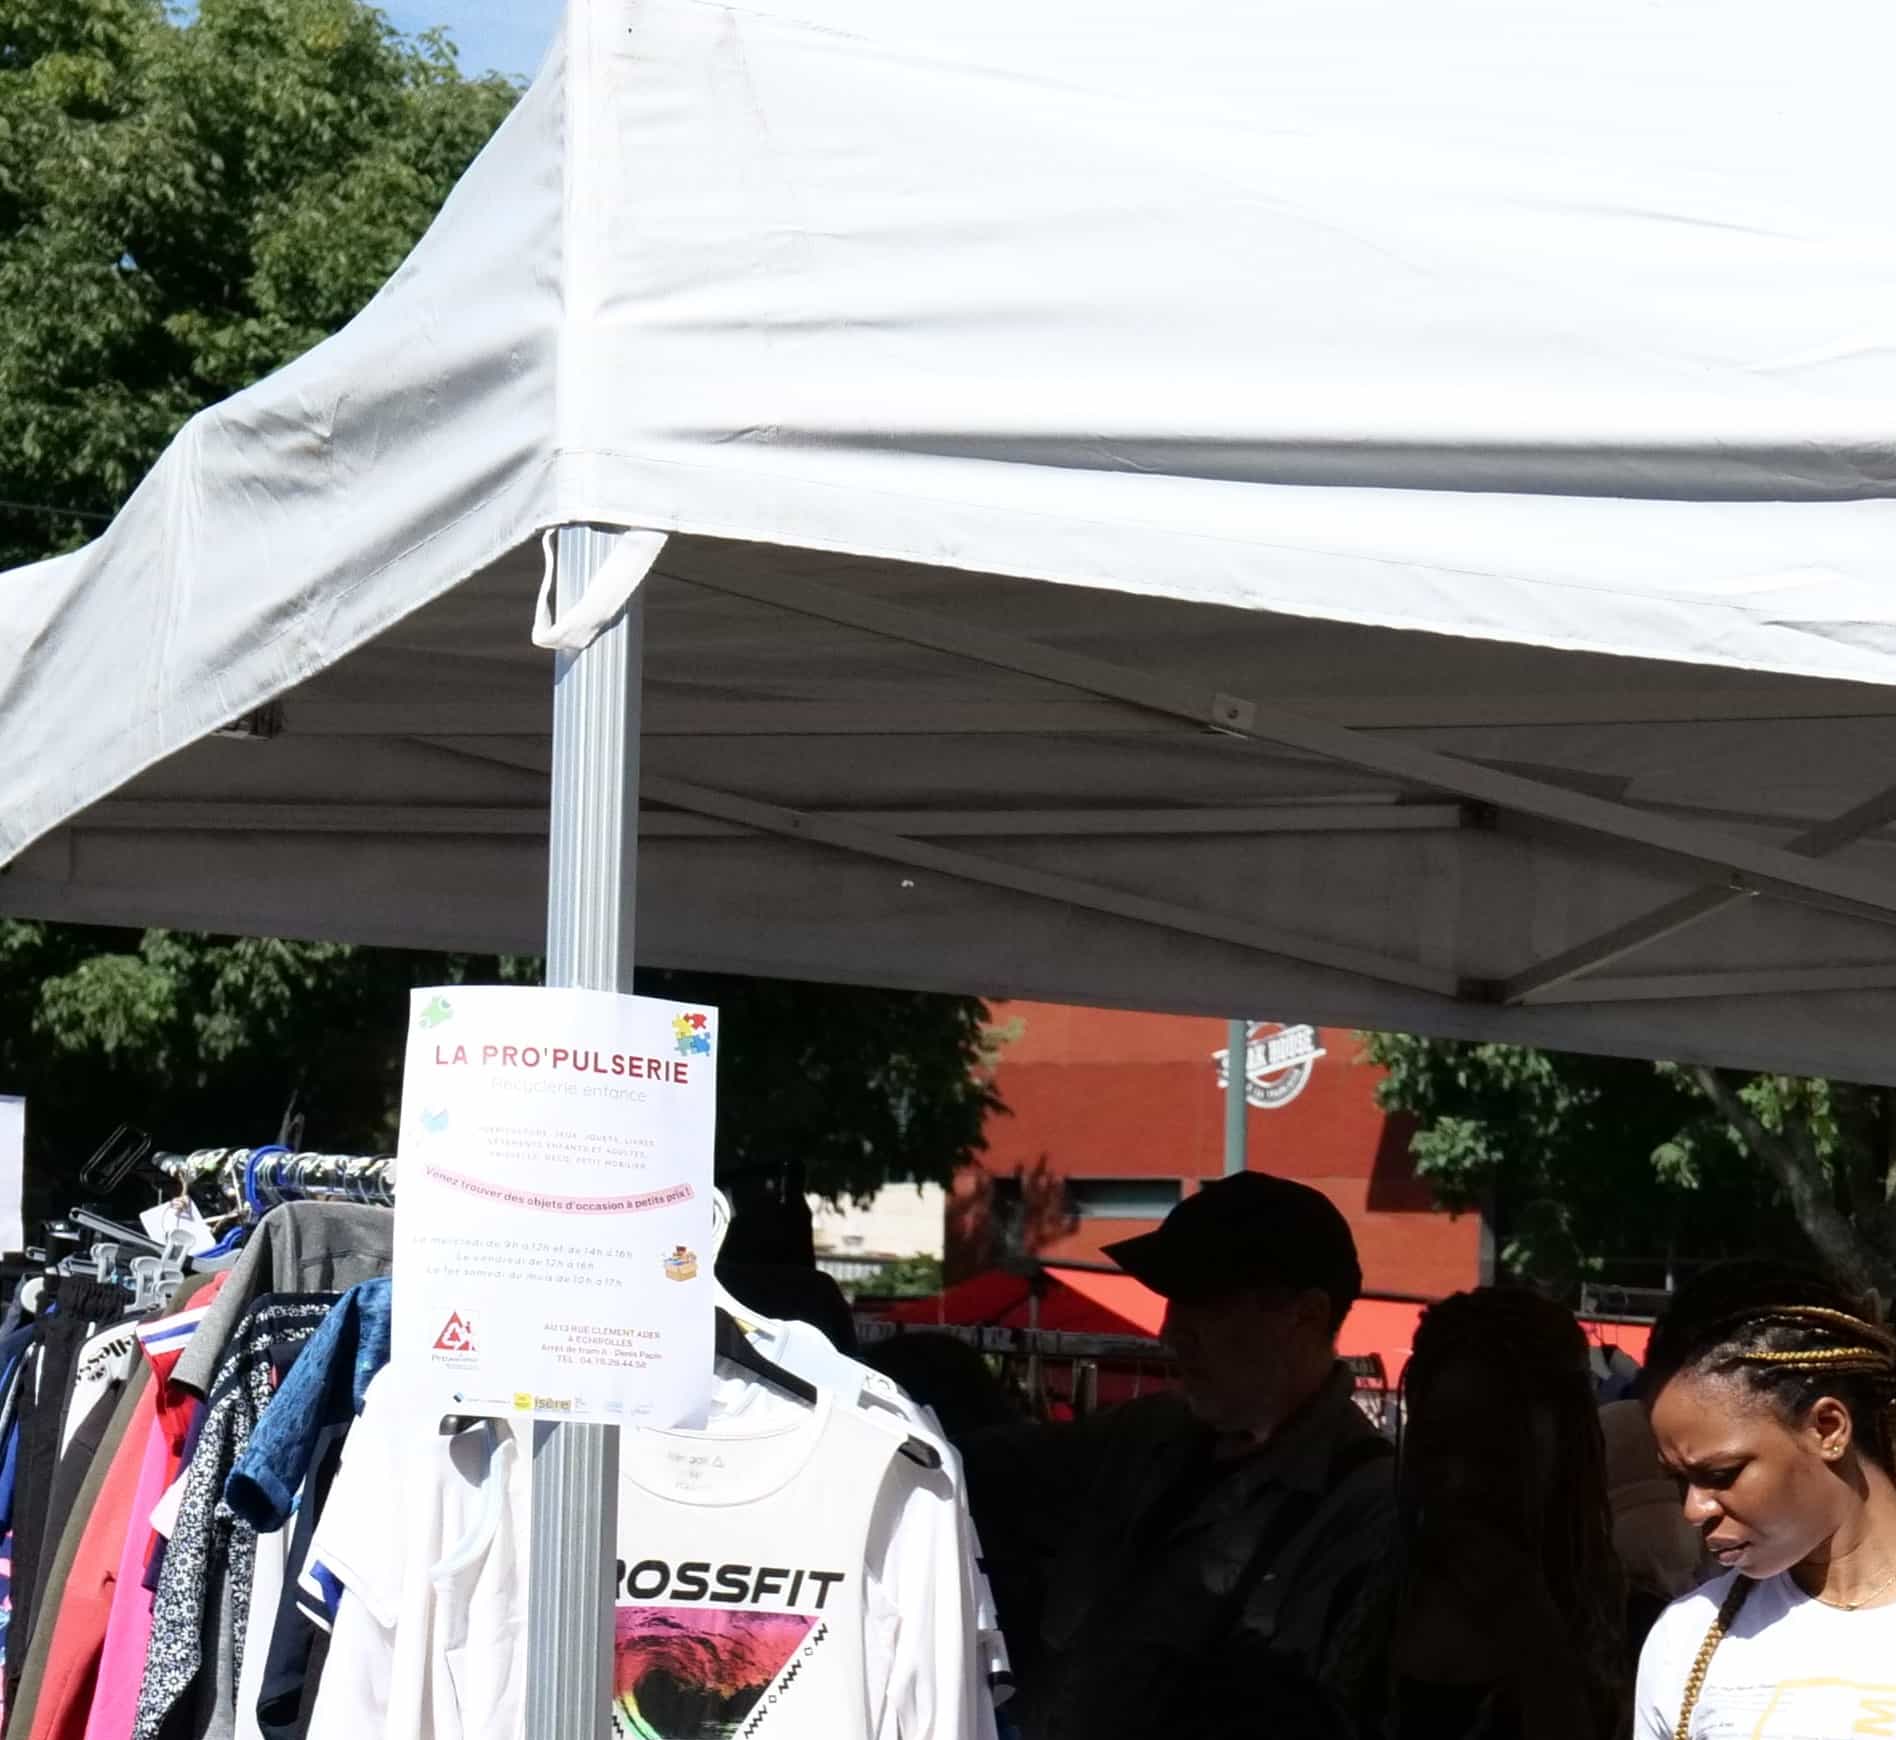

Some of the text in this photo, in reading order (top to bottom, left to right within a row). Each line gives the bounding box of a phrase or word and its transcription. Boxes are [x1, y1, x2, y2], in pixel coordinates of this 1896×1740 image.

[435, 1045, 689, 1084] LA PRO'PULSERIE
[425, 1166, 458, 1185] Venez
[462, 1180, 502, 1199] trouver
[504, 1193, 524, 1203] des
[528, 1196, 563, 1209] objets
[616, 1559, 846, 1609] OSSFIT
